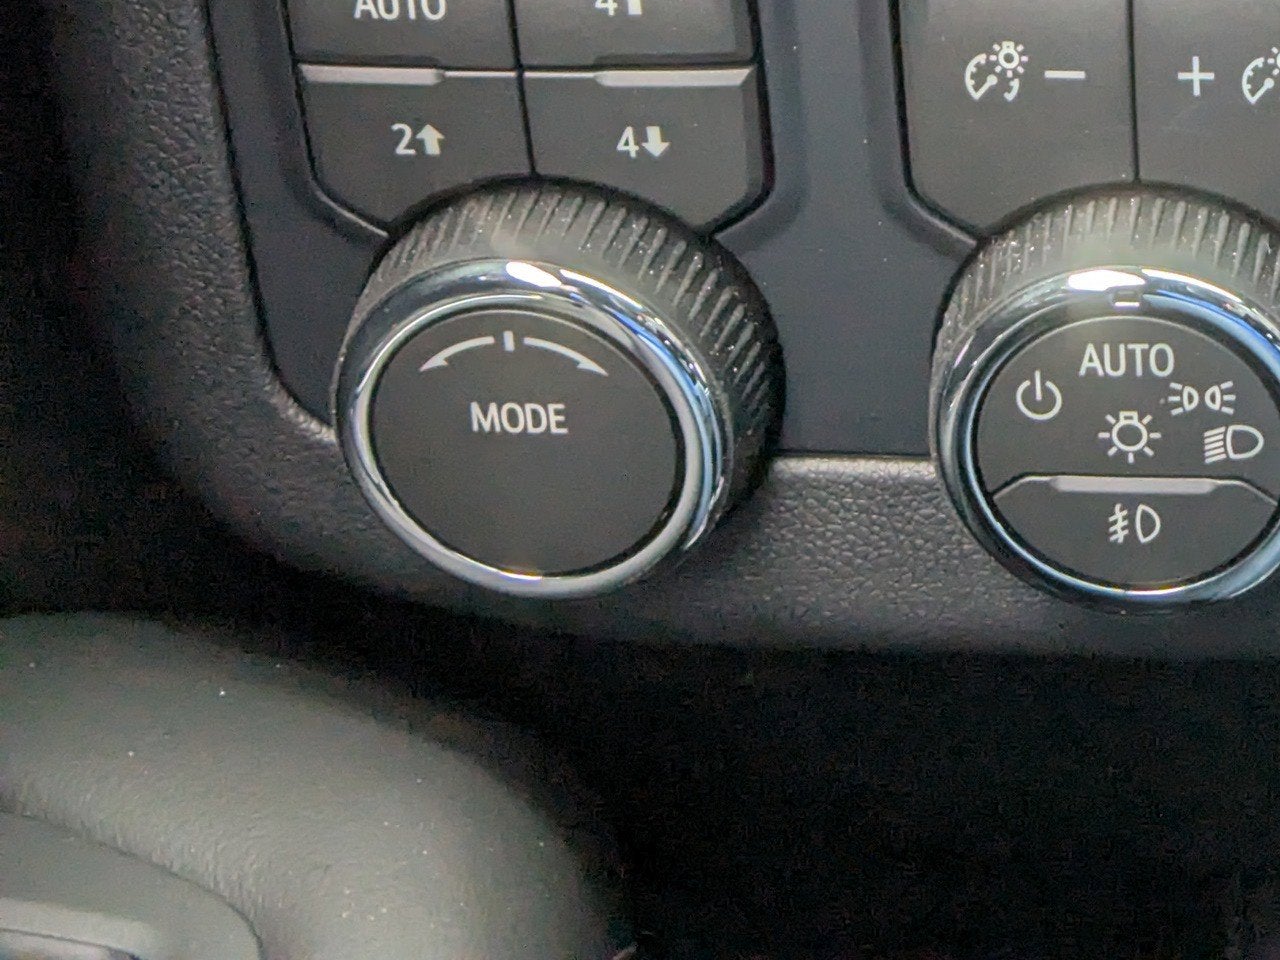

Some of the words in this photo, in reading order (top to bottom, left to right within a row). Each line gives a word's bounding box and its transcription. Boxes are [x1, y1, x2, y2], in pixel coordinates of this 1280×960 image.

[392, 124, 415, 155] 2
[617, 127, 640, 158] 4
[1078, 343, 1174, 378] AUTO
[471, 402, 568, 434] MODE
